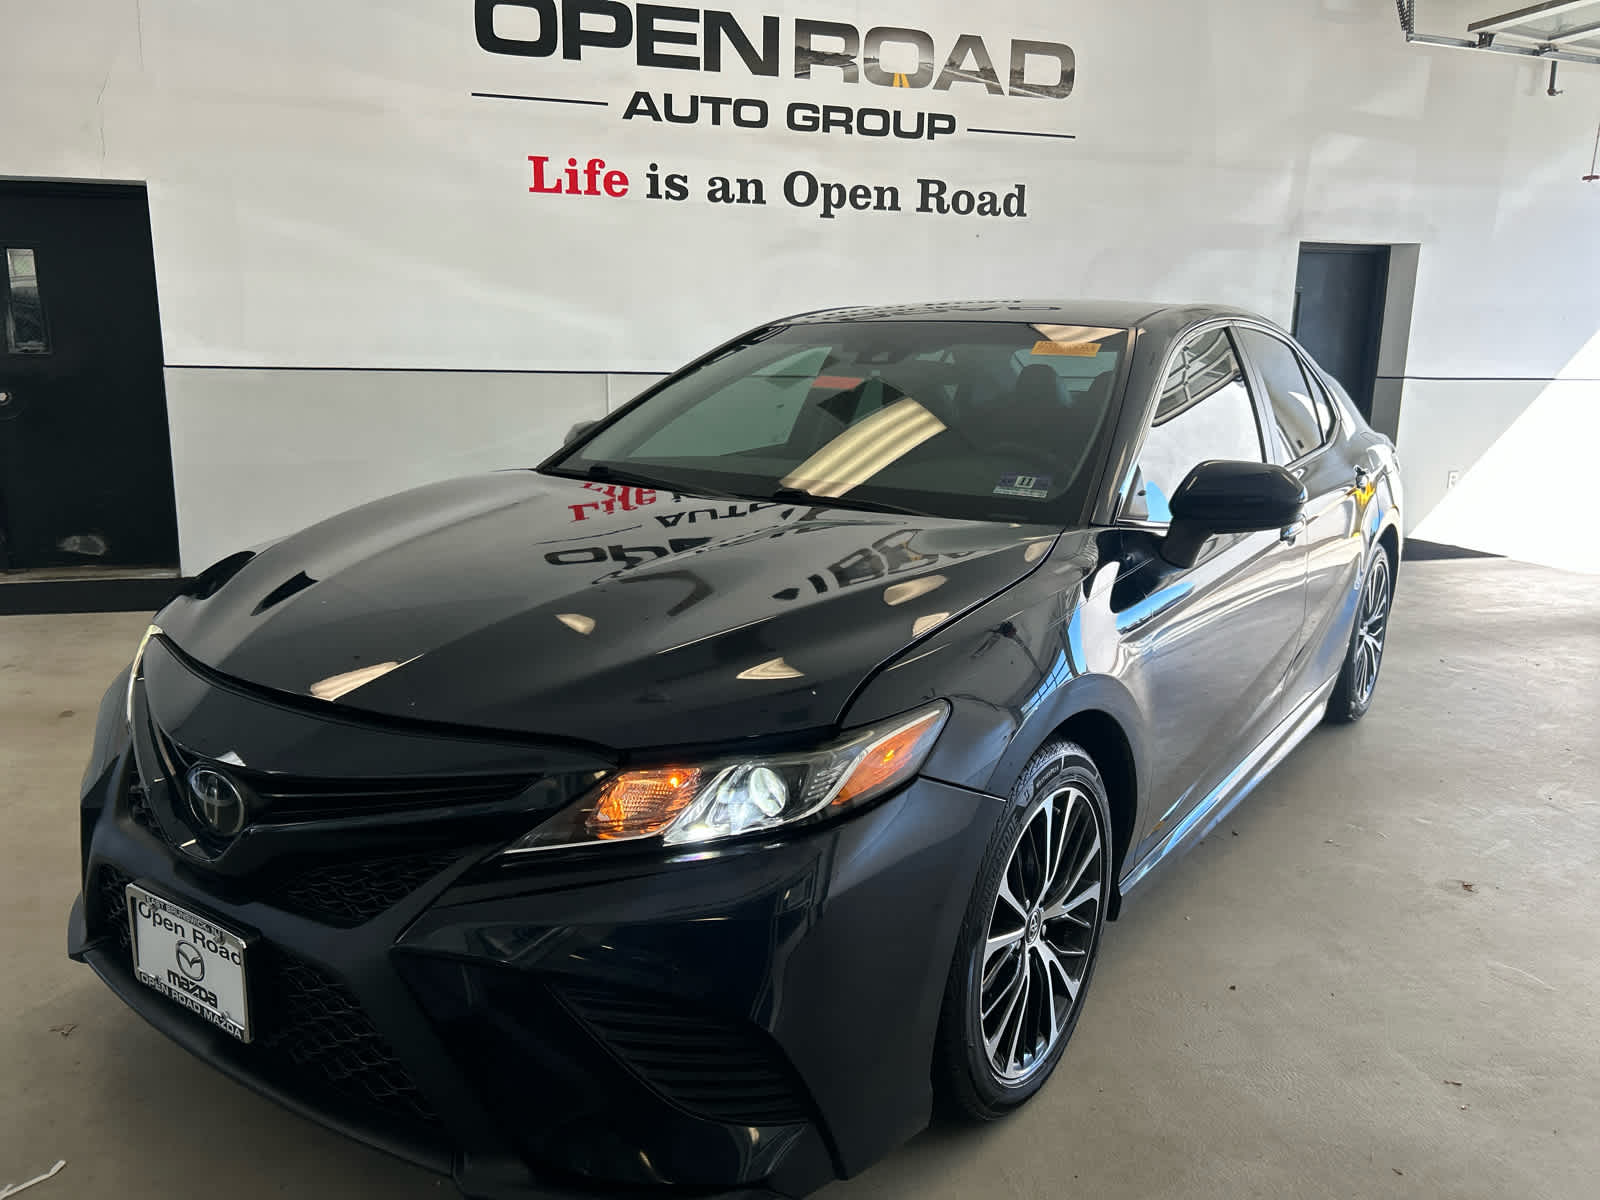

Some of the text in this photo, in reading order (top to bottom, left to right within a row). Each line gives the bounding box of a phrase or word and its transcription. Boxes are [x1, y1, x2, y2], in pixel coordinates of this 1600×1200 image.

[475, 0, 1076, 99] OPEN ROAD
[623, 91, 957, 140] AUTO GROUP
[527, 156, 1028, 219] Life is an Open Road
[138, 901, 185, 938] Open
[140, 971, 242, 1040] OPEN ROAD MAZDA
[167, 968, 218, 1009] mazda
